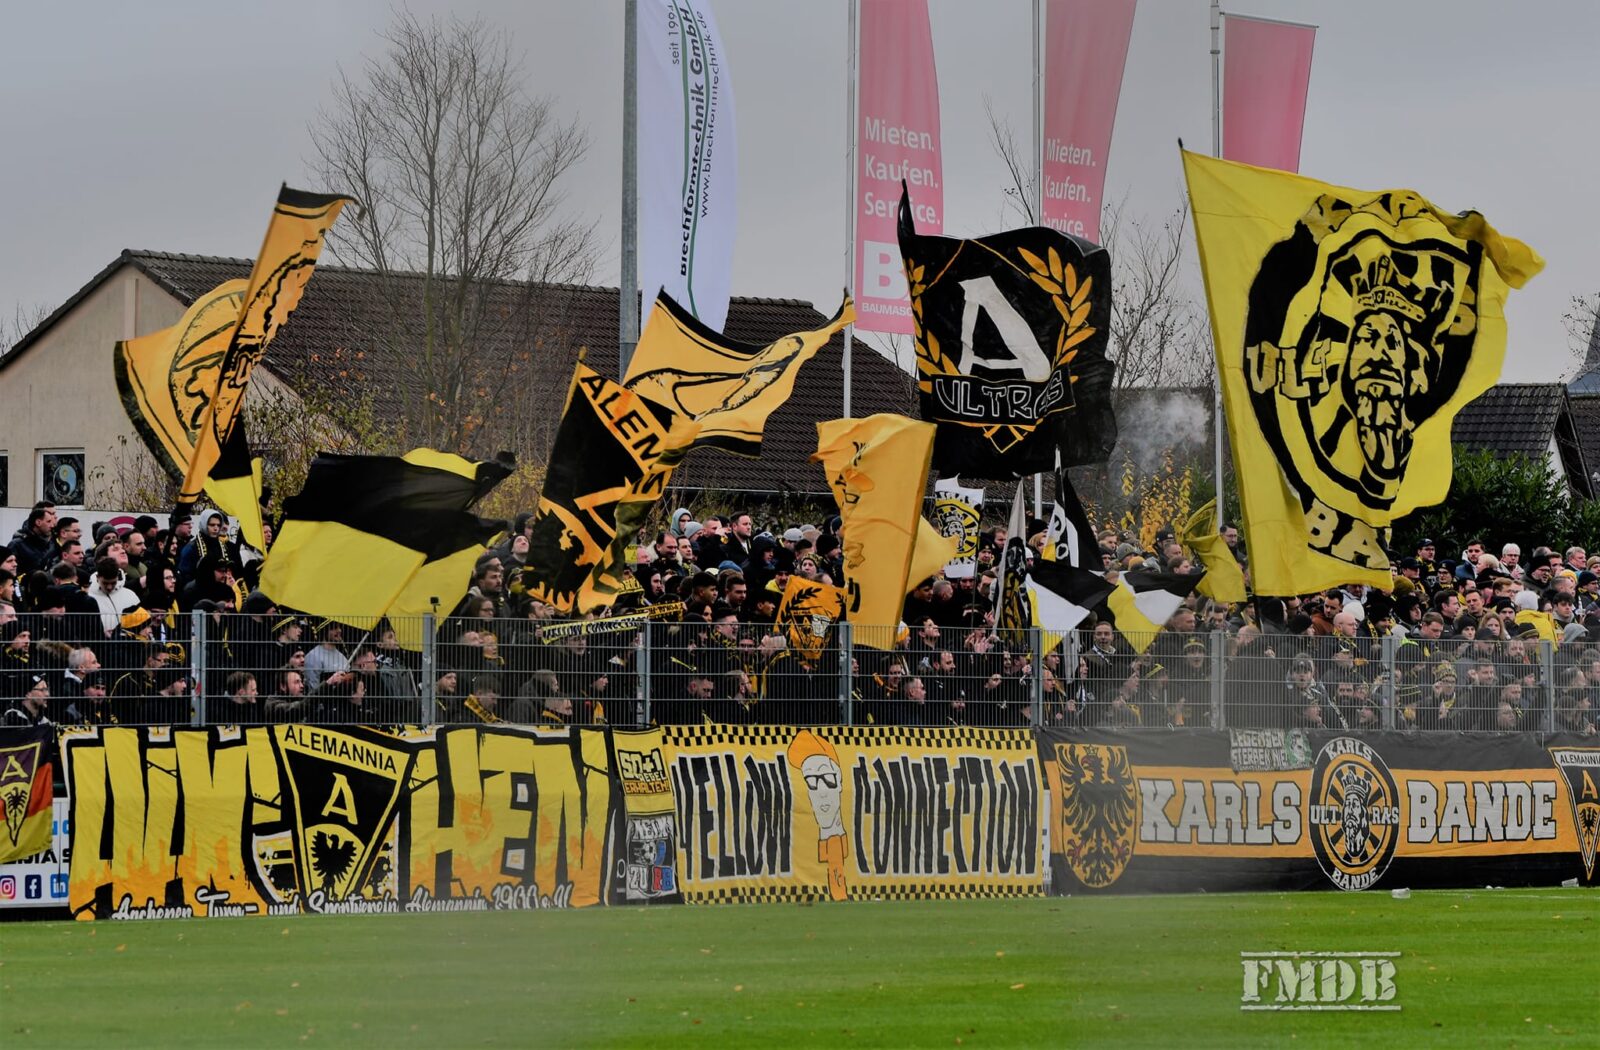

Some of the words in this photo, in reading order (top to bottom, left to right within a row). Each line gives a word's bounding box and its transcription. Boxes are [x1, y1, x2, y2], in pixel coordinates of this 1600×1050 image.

[671, 42, 680, 65] seit
[679, 7, 703, 76] GmbH
[864, 116, 935, 152] Mieten.
[1047, 138, 1096, 167] Mieten.
[864, 153, 939, 188] Kaufen.
[1045, 175, 1091, 202] Kaufen.
[864, 192, 941, 225] Serice.
[958, 275, 1051, 383] A
[284, 727, 397, 774] ALEMANNIA
[1326, 739, 1373, 760] KARLS
[1, 756, 28, 781] A
[1581, 769, 1598, 799] A
[321, 772, 358, 825] A
[1138, 779, 1302, 844] KARLS
[1310, 805, 1340, 825] ULT
[1371, 805, 1400, 825] RAS
[1406, 780, 1557, 843] BANDE
[670, 752, 793, 882] YELLOW
[852, 754, 1041, 876] CONNECTION
[1331, 867, 1379, 889] BANDE
